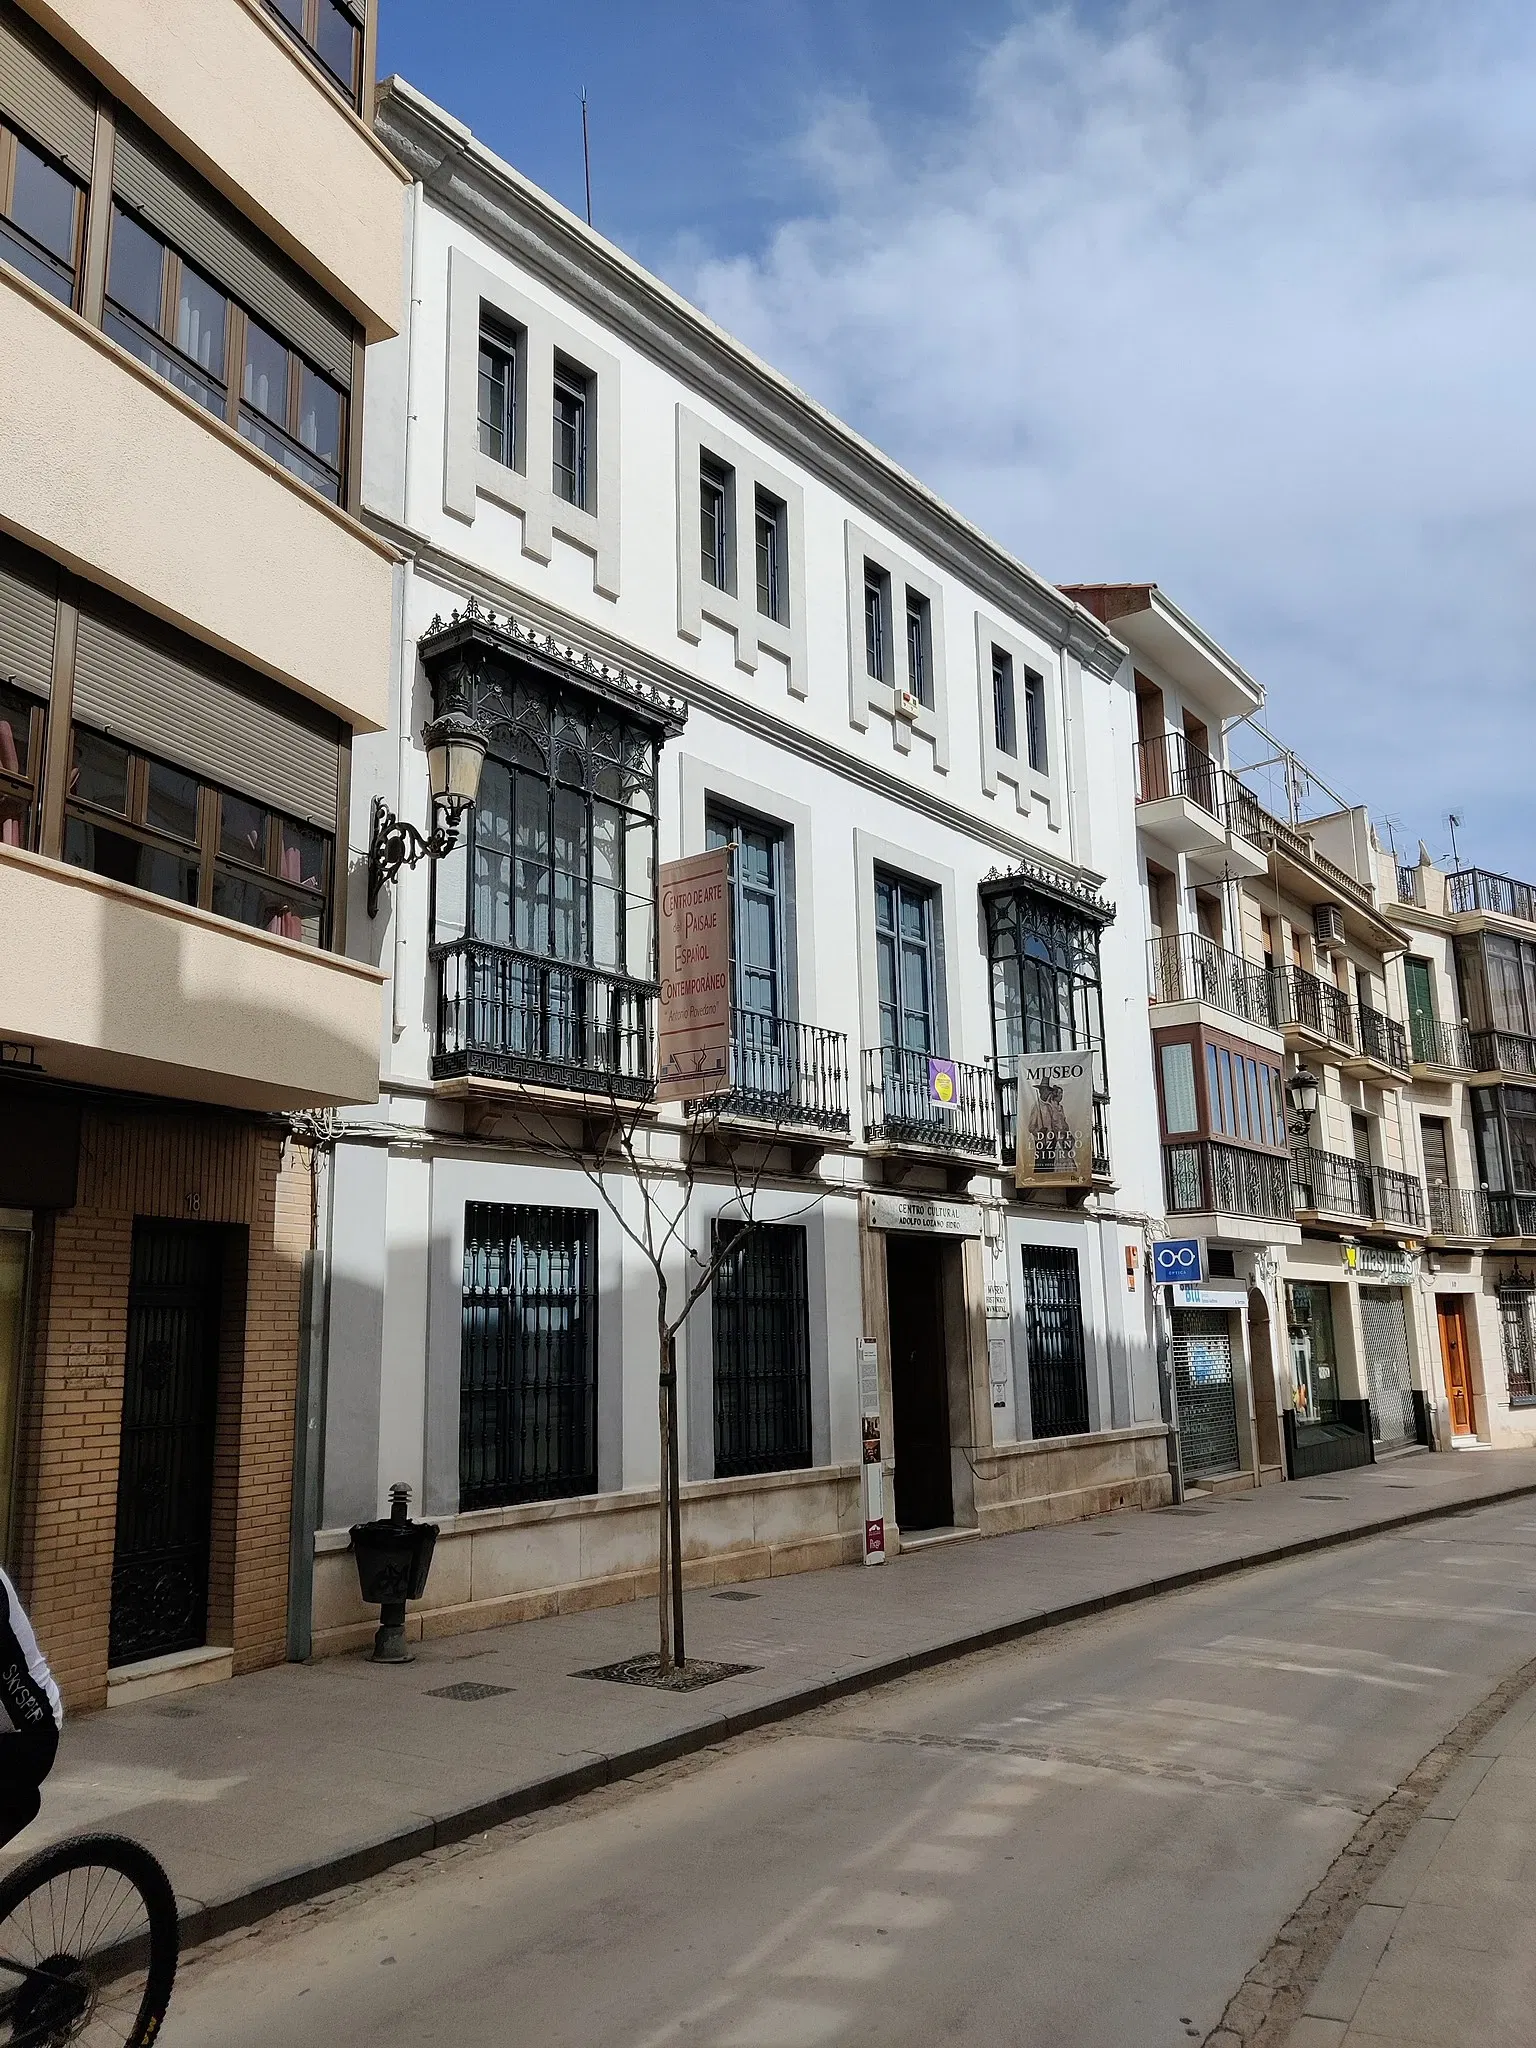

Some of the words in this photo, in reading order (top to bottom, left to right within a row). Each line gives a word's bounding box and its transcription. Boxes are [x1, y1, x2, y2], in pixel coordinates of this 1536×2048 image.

[662, 891, 692, 917] CENTRO
[694, 889, 702, 905] DE
[704, 884, 722, 903] ARTE
[685, 912, 717, 939] PAISAJE
[675, 944, 709, 972] ESPAÑOL
[660, 972, 726, 1006] CONTEMPORÁNEO
[1026, 1064, 1084, 1080] MUSEO
[1028, 1130, 1083, 1141] ADOLFO
[1028, 1140, 1083, 1150] LOZANO
[1034, 1150, 1076, 1159] SIDRO
[186, 1193, 200, 1211] 18
[898, 1203, 925, 1216] CENTRO
[927, 1206, 960, 1219] CULTURAL
[899, 1217, 921, 1226] ADOLFO
[923, 1219, 944, 1228] LOZANO
